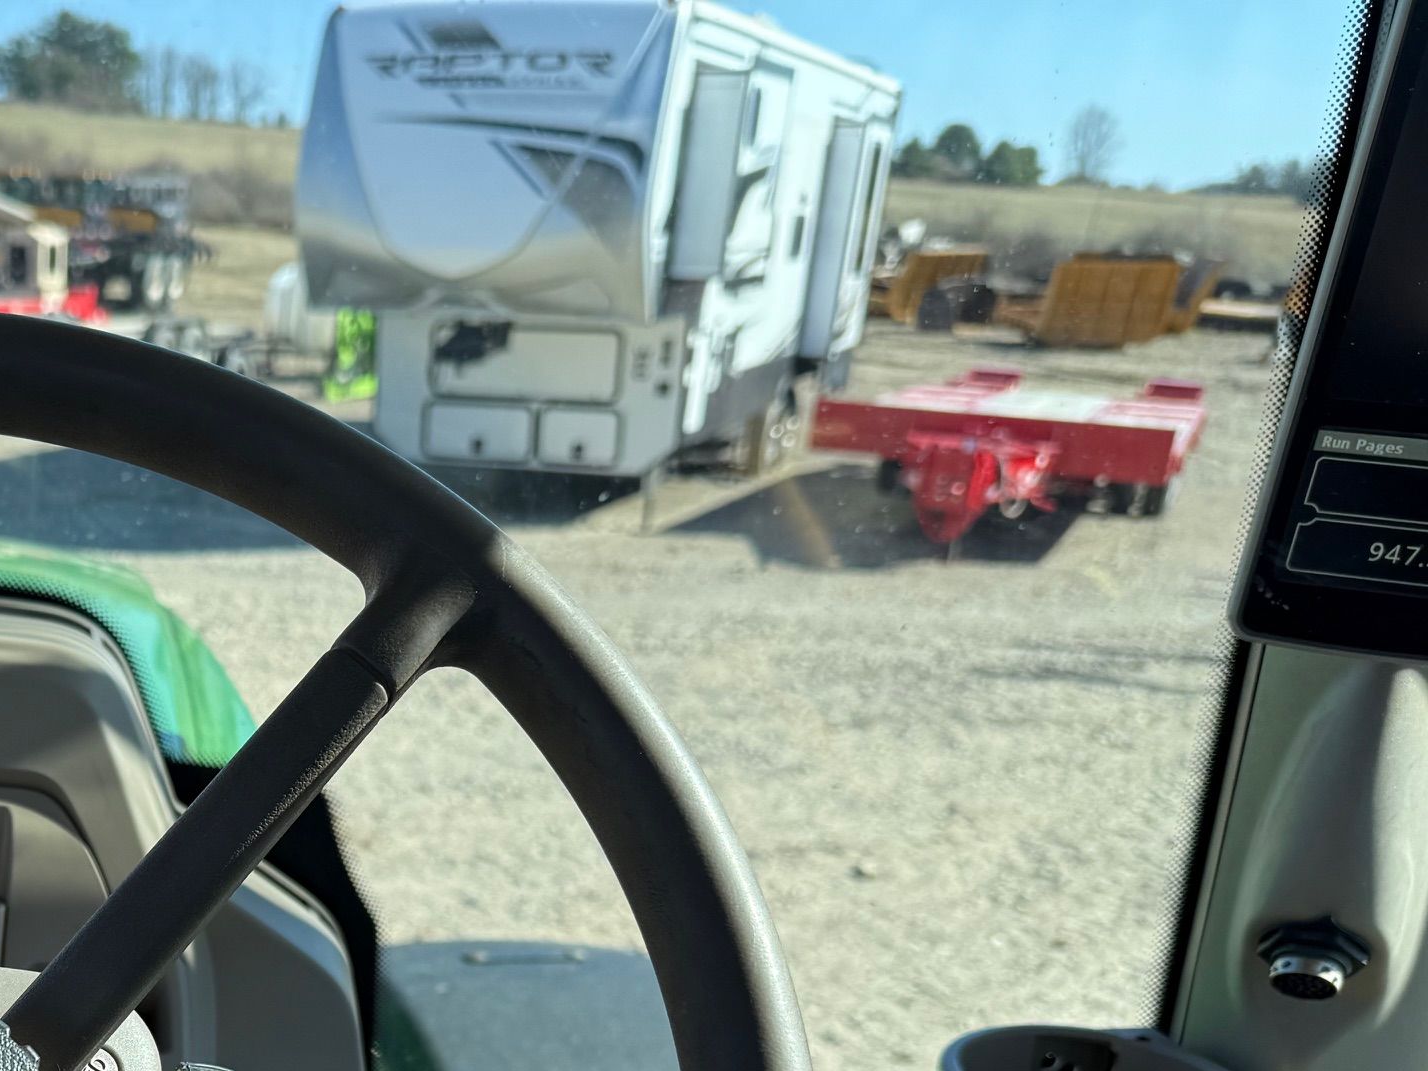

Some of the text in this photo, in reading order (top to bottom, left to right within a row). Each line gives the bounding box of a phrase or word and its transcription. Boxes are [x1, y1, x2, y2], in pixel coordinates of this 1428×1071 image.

[365, 51, 615, 79] RAPTOR
[1322, 435, 1405, 456] Run Pages
